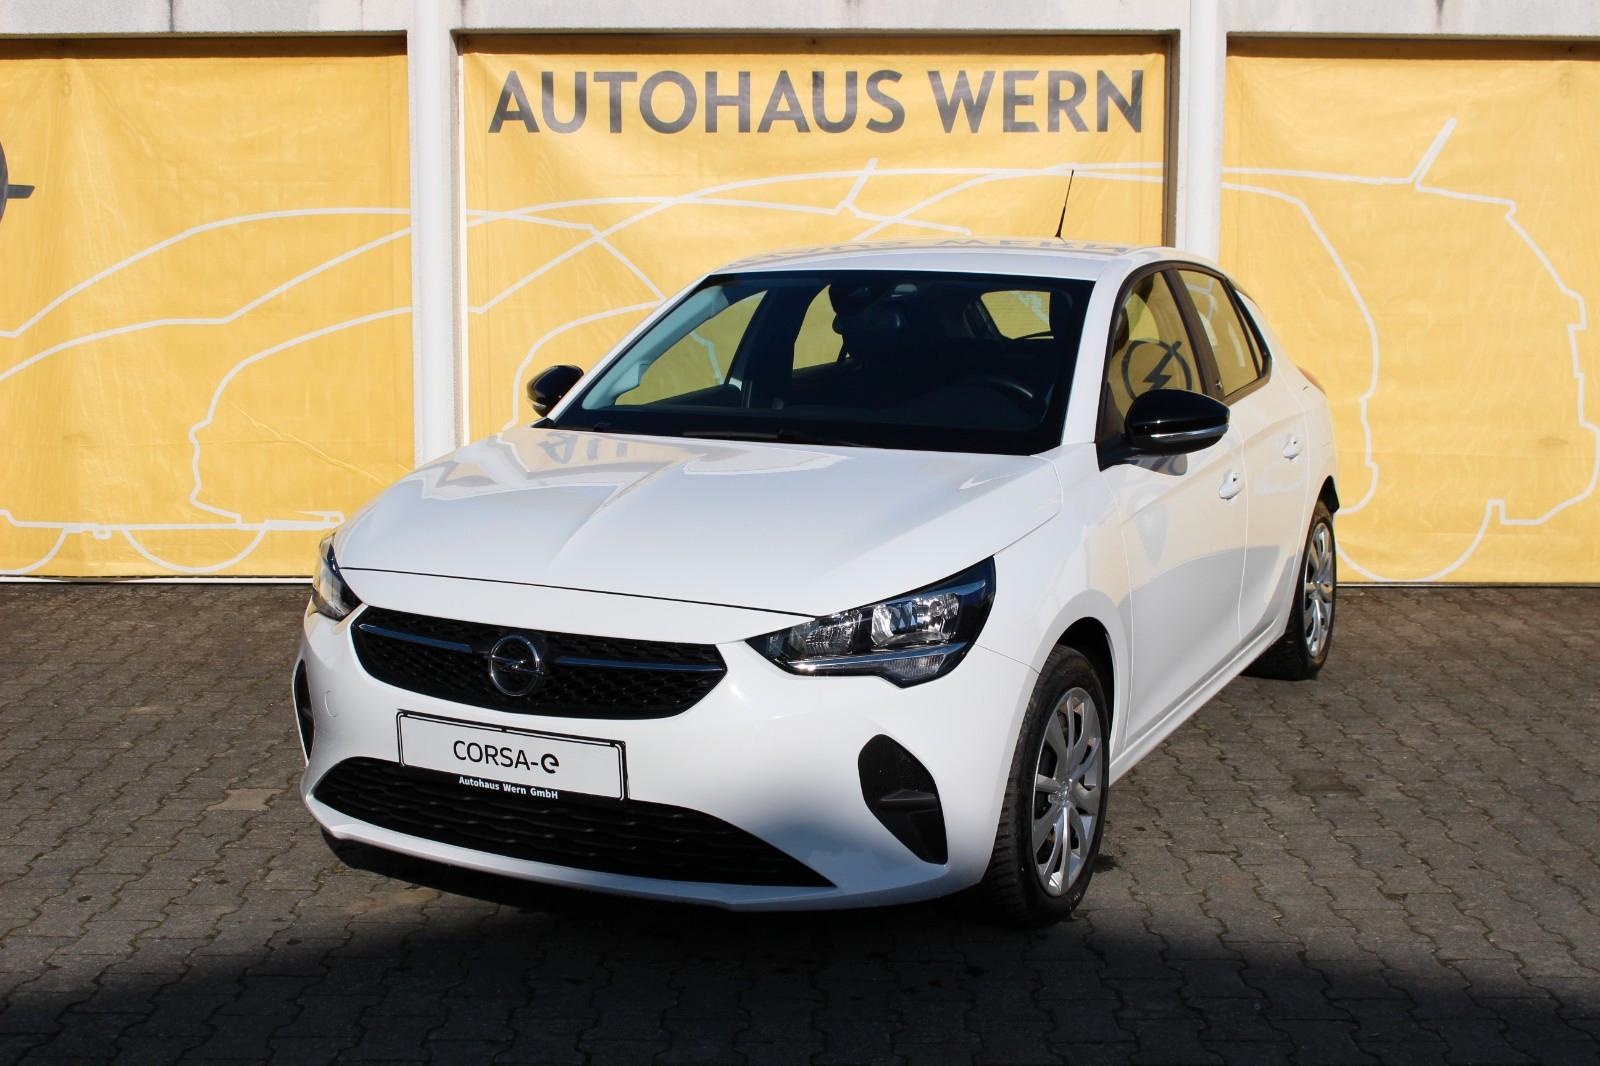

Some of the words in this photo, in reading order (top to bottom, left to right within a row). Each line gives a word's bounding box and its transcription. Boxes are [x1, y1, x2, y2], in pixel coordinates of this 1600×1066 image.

[488, 70, 905, 134] AUTOHAUS
[928, 70, 1144, 133] WERN
[453, 740, 560, 774] CORSA-e
[459, 776, 500, 790] Autohaus
[503, 783, 527, 795] Wern
[530, 787, 559, 799] GmbH
